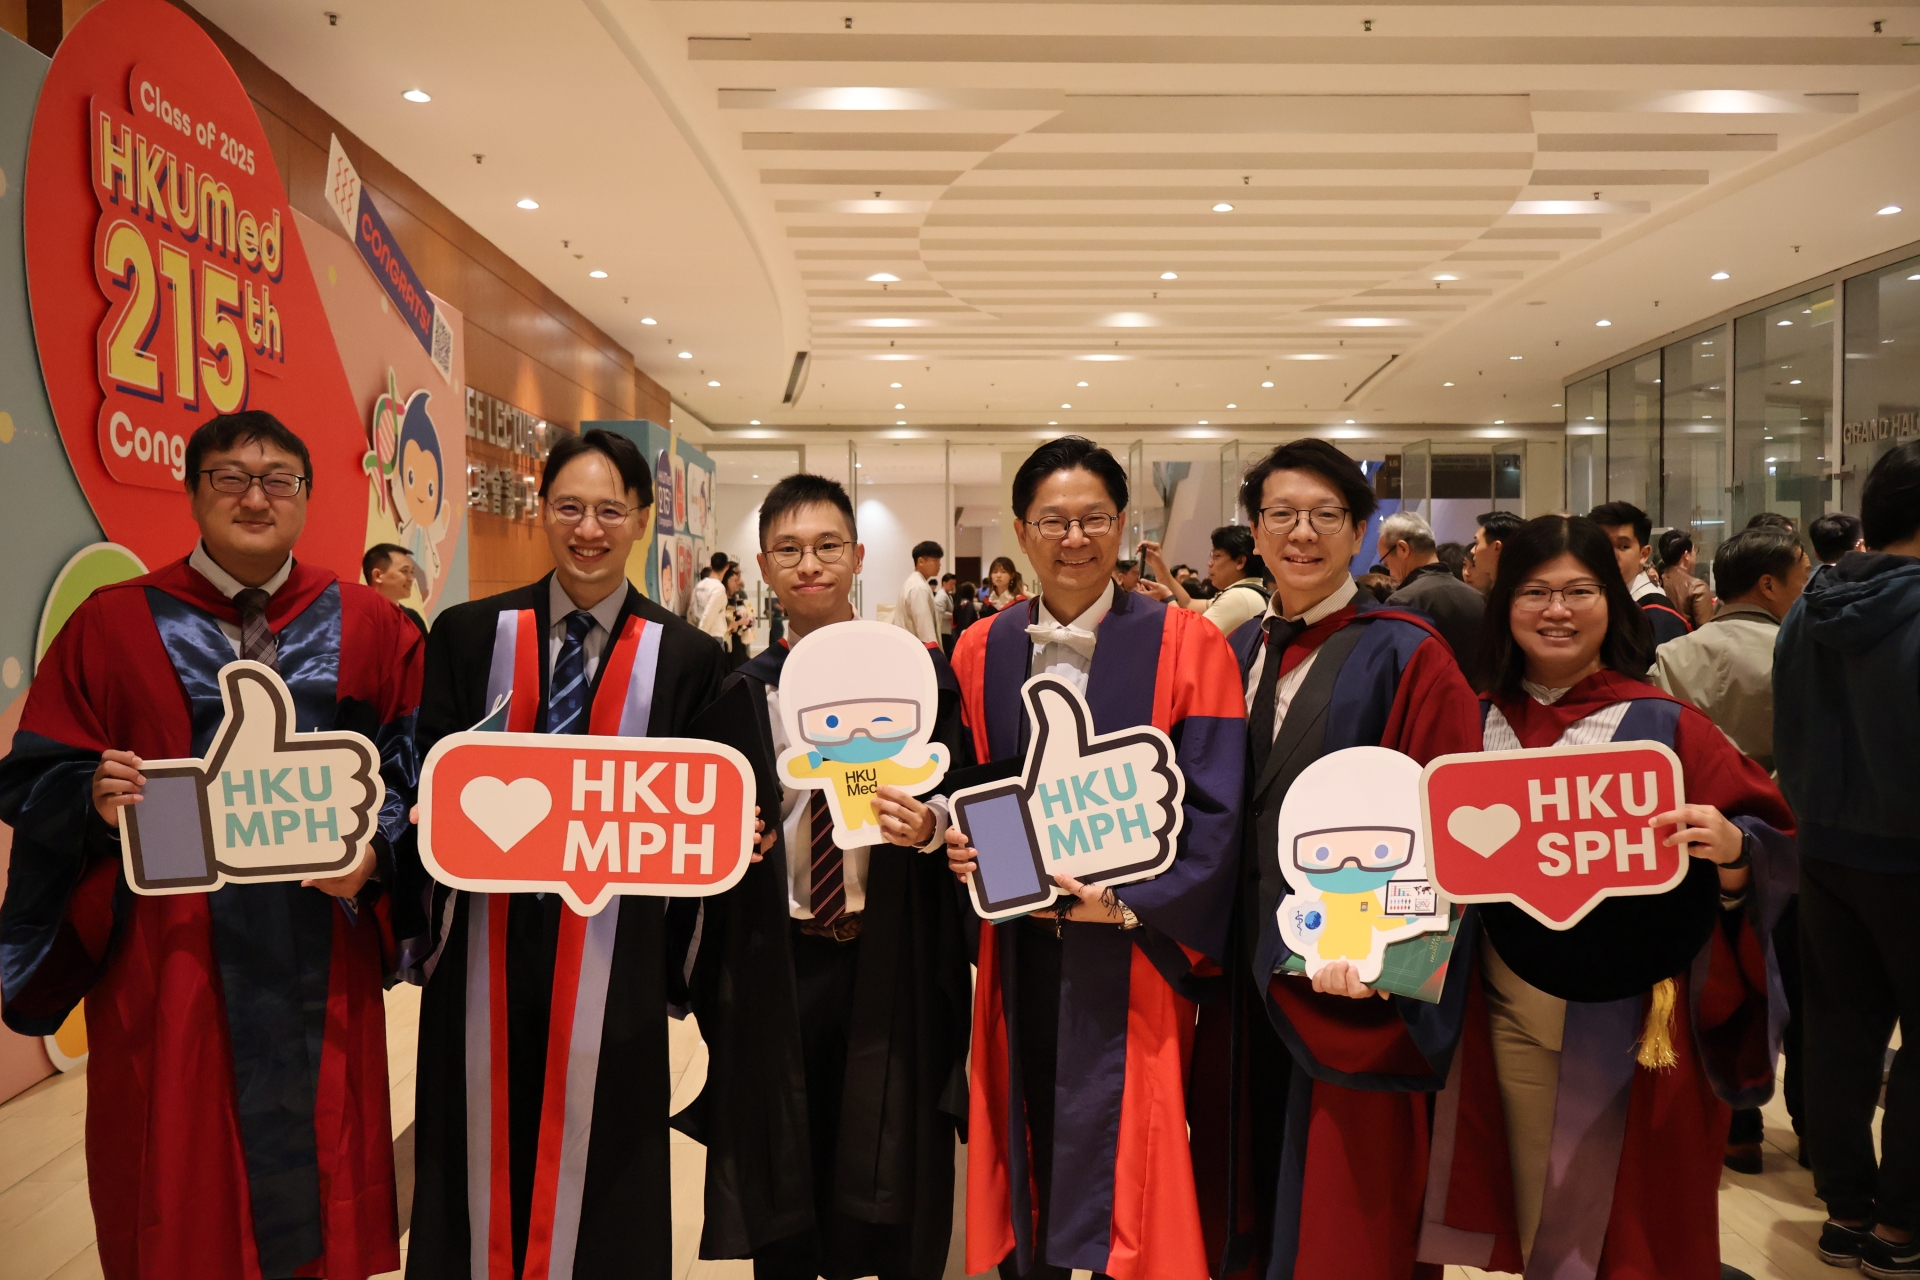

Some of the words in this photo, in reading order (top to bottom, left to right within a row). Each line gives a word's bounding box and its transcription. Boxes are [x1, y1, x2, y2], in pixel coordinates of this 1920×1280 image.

[140, 81, 191, 136] Class
[196, 121, 216, 149] of
[220, 132, 256, 176] 2025
[1844, 419, 1888, 445] GRAND
[221, 765, 333, 806] HKU
[571, 758, 718, 816] HKU
[845, 768, 877, 784] HKU
[847, 781, 877, 796] Med
[1038, 762, 1138, 819] HKU
[1527, 770, 1659, 823] HKU
[225, 807, 340, 848] MPH
[562, 819, 716, 875] MPH
[1047, 803, 1152, 861] MPH
[1537, 827, 1657, 877] SPH
